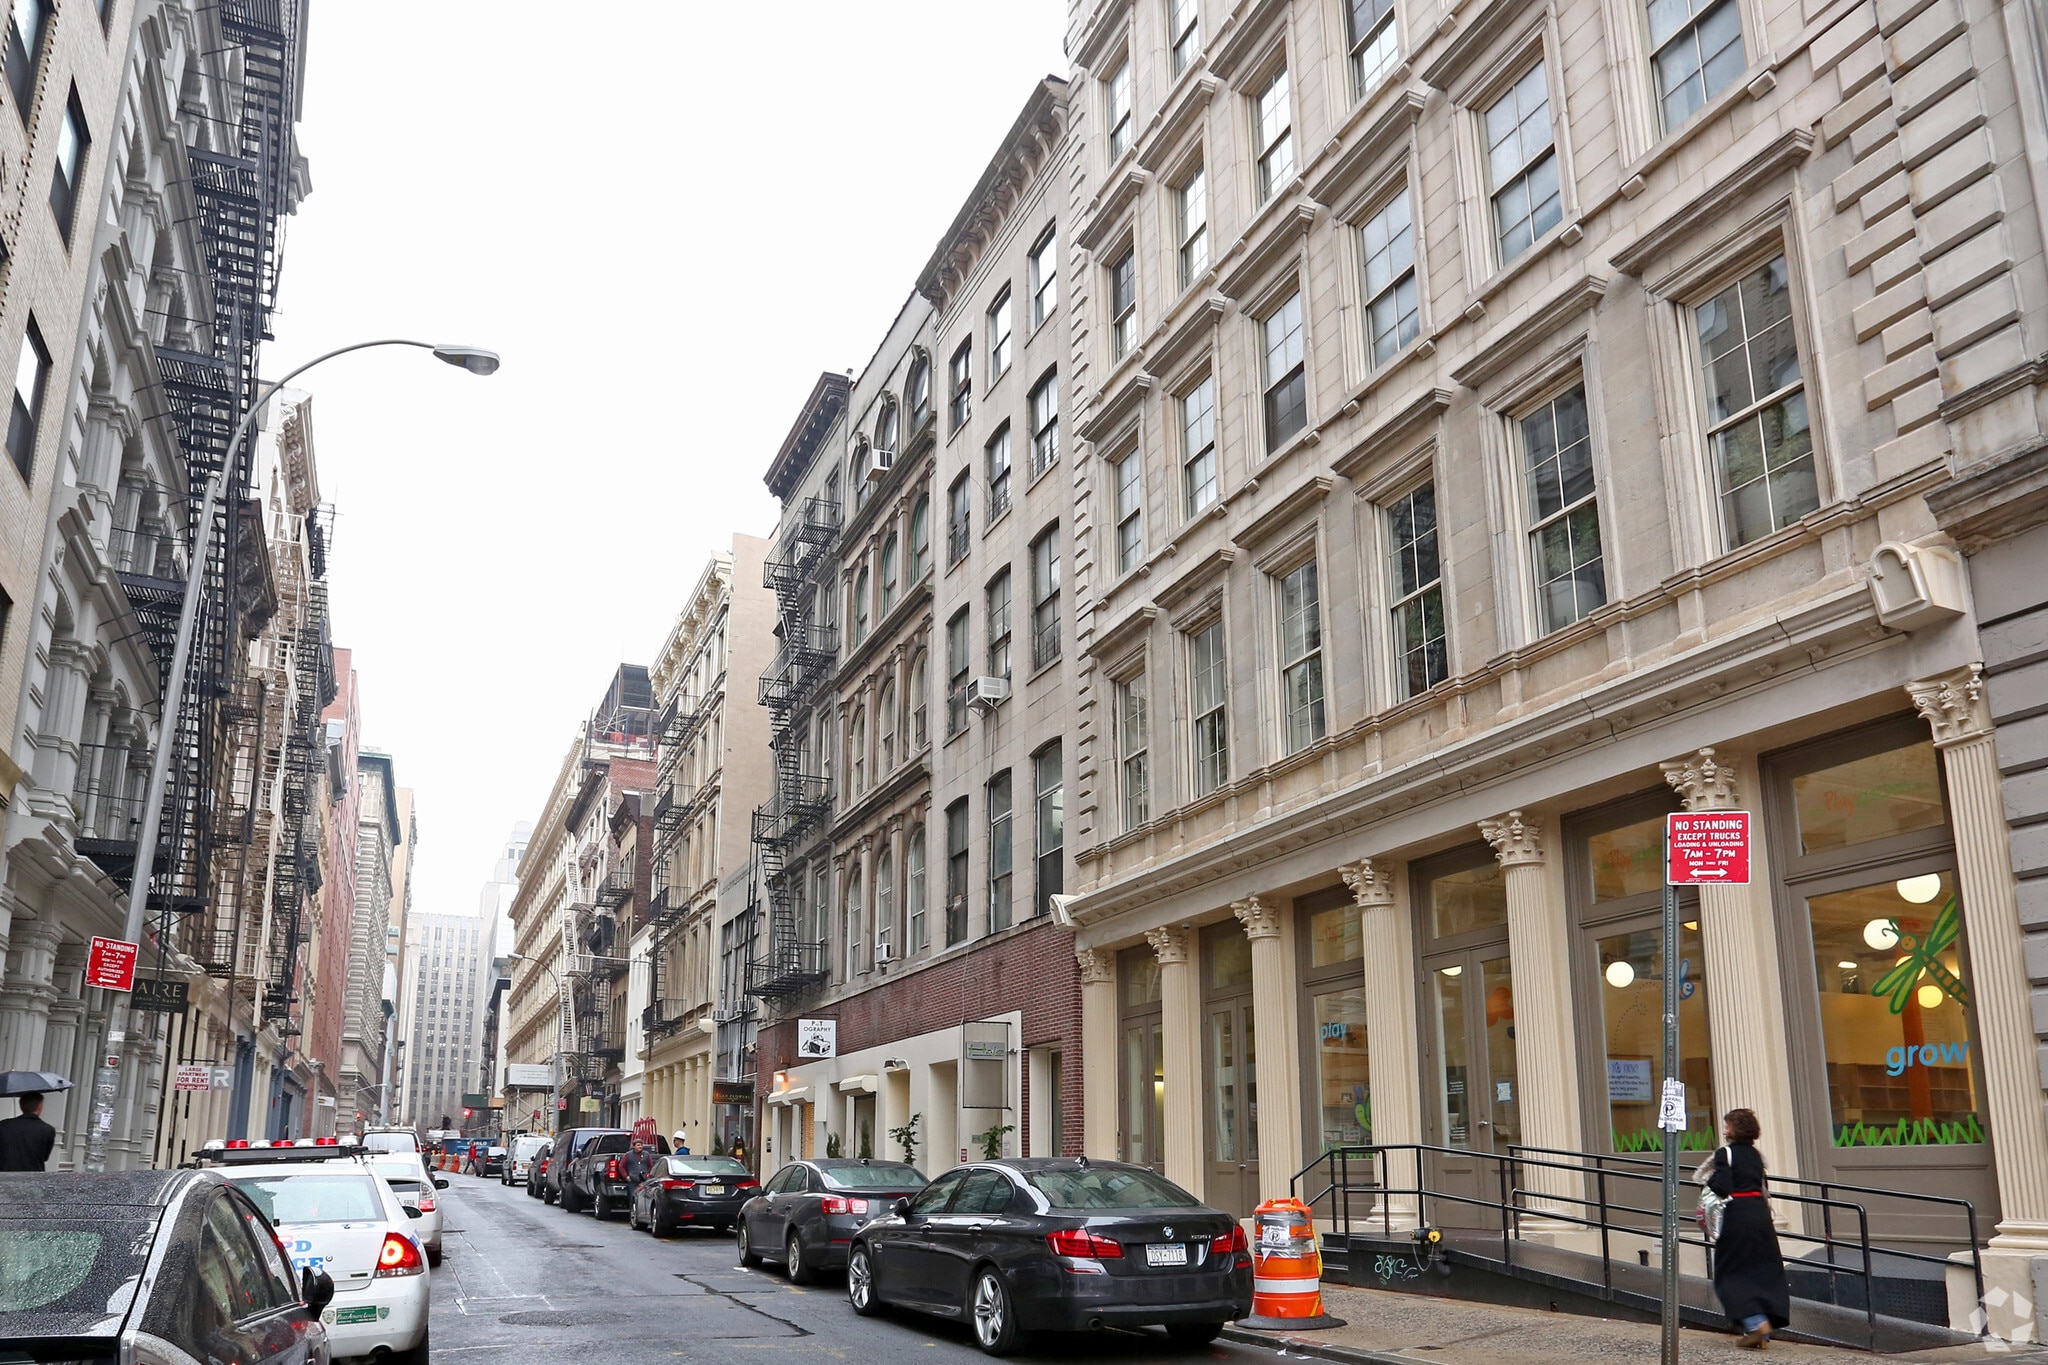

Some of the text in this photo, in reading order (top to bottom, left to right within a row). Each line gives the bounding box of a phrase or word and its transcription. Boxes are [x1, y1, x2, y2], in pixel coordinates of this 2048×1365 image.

[1675, 820, 1743, 831] NO STANDING
[1677, 832, 1741, 841] EXCEPT TRUCKS
[1682, 849, 1703, 859] 7AM
[1714, 848, 1736, 859] 7PM
[95, 940, 135, 953] NO STANDING
[136, 981, 182, 998] AIRE
[1320, 1019, 1348, 1044] play
[1886, 1041, 1970, 1077] grow
[214, 1069, 230, 1087] R
